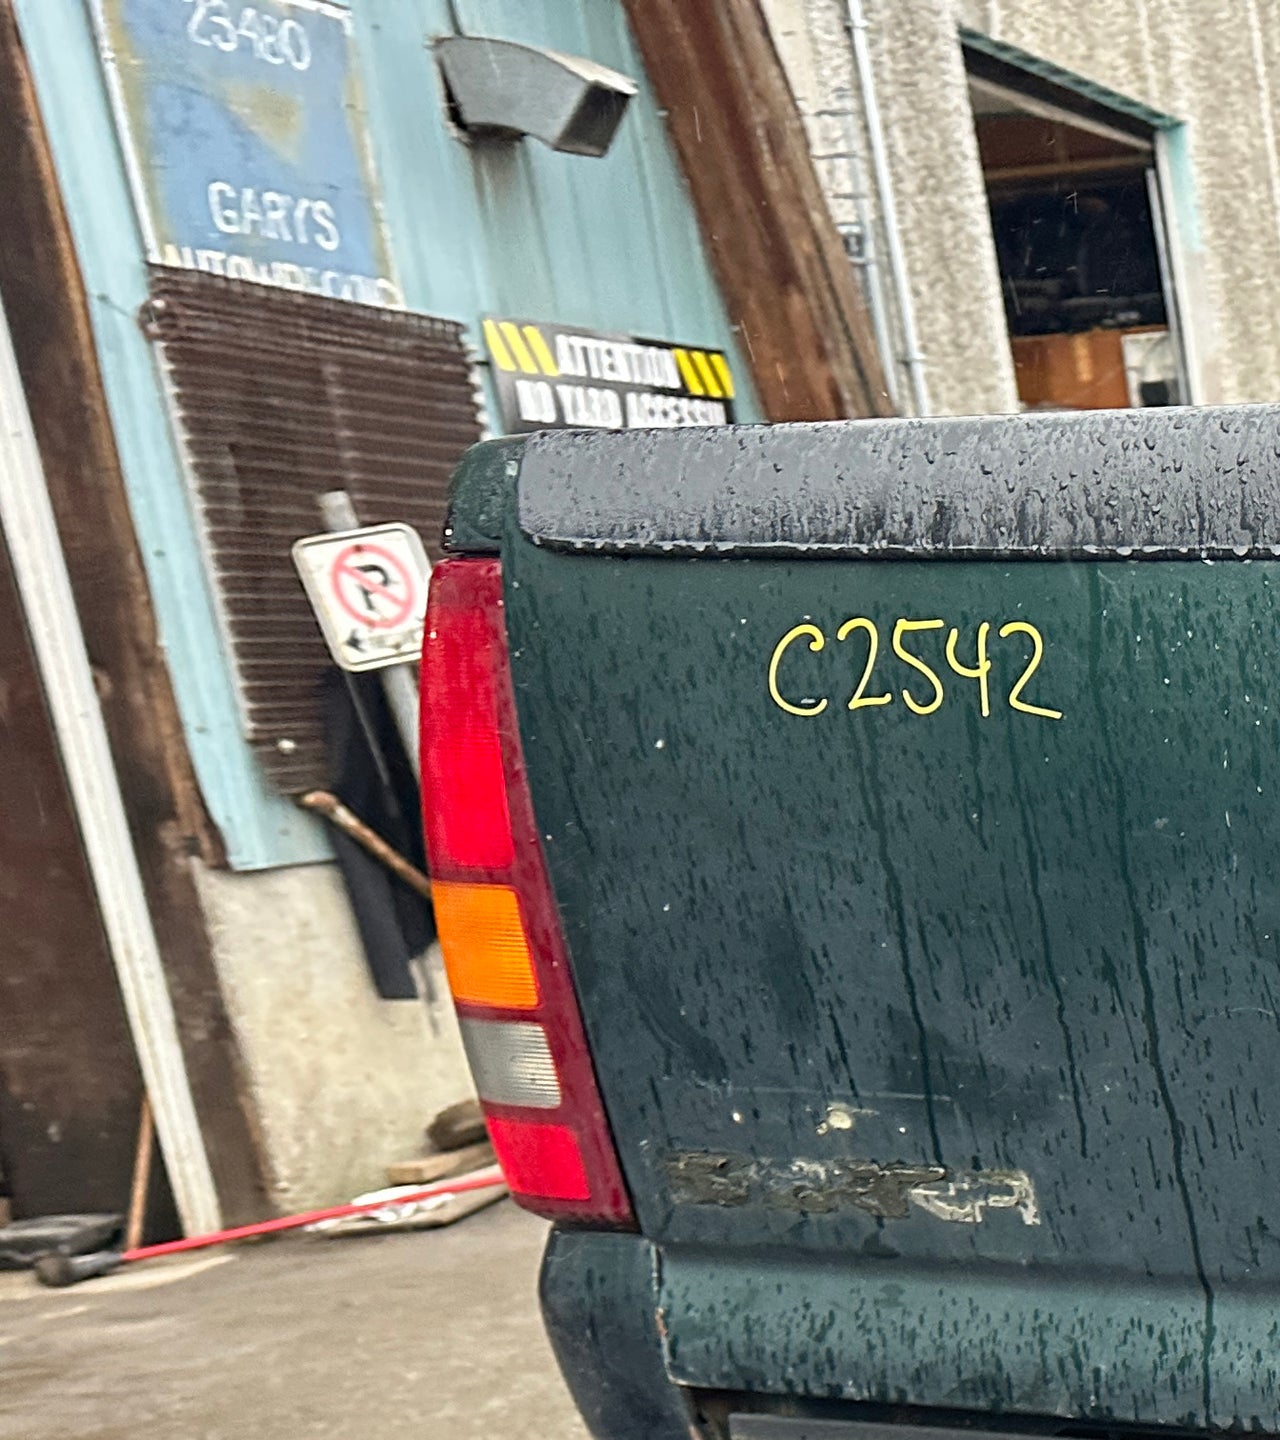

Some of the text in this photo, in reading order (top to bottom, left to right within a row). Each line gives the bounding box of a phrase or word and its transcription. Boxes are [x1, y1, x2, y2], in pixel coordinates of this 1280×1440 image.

[207, 181, 340, 252] GARYS
[555, 334, 681, 388] ATTENTION
[515, 379, 556, 423] NO
[555, 384, 623, 428] YARD
[768, 617, 1063, 716] C2542
